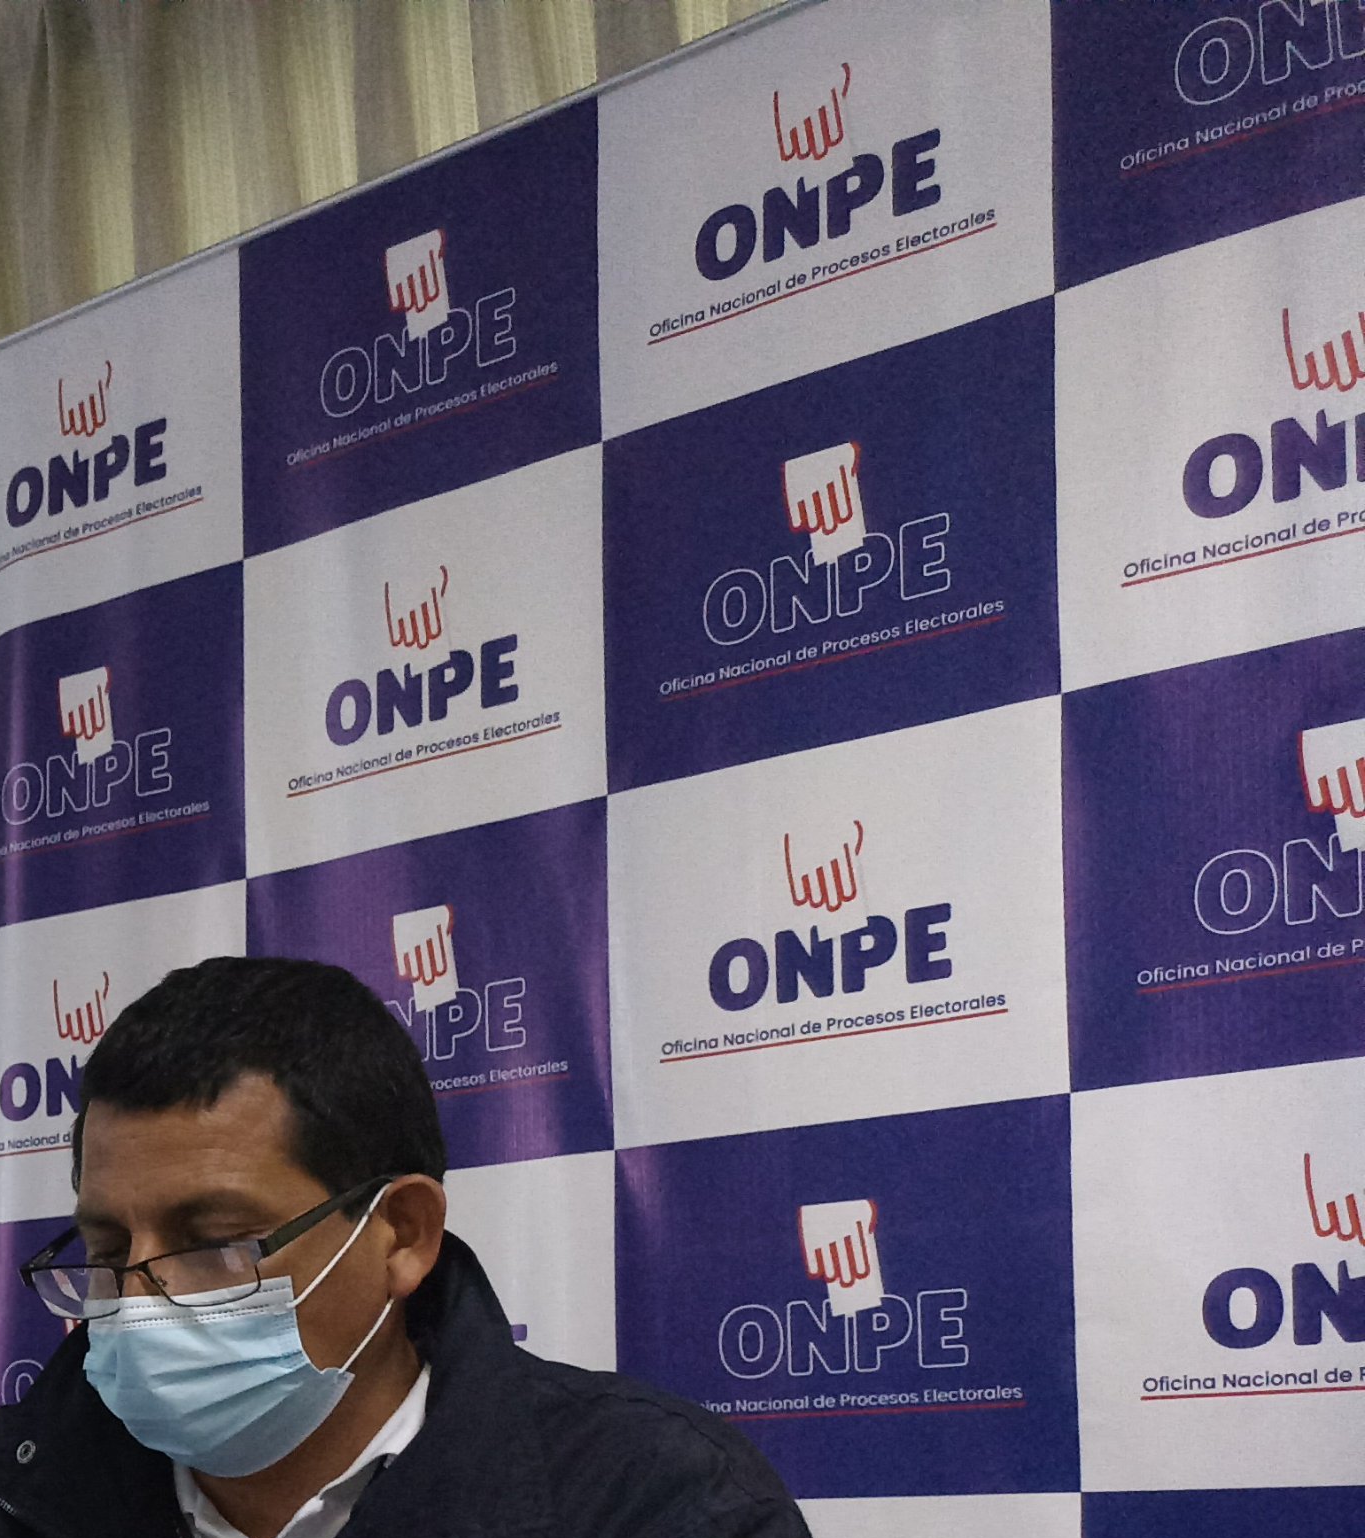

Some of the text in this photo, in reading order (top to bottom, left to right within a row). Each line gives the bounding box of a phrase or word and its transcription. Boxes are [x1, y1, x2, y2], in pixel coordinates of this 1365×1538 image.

[1175, 0, 1365, 106] ON
[1120, 138, 1190, 171] Oficina
[1195, 102, 1287, 145] Nacional
[695, 127, 943, 282] ONPE
[649, 207, 996, 339] Oficina Nacional de Procesos Electorales
[320, 287, 517, 418] ONPE
[332, 416, 391, 450] Nacional
[414, 389, 477, 423] Procesos
[480, 361, 560, 403] Electorales
[5, 417, 167, 528] ONPE
[1182, 408, 1365, 519] ON
[703, 512, 951, 647] ONPE
[1124, 551, 1197, 579] Oficina
[1203, 523, 1297, 561] Nacional
[1303, 518, 1331, 535] de
[325, 633, 520, 747] ONPE
[659, 600, 1005, 697] Oficina Nacional de Procesos Electorales
[1, 727, 173, 827] ONPE
[287, 711, 561, 791] Oficina Nacional de Procesos Electorales
[709, 902, 953, 1012] ONPE
[1137, 962, 1210, 986] Oficina
[1215, 944, 1311, 974] Nacional
[1317, 940, 1346, 960] de
[661, 991, 1006, 1056] Oficina Nacional de Procesos Electorales
[430, 1060, 569, 1092] rocesos Electorales
[718, 1287, 970, 1380] ONPE
[1142, 1375, 1216, 1393] Oficina
[1222, 1369, 1318, 1389] Nacional
[1324, 1367, 1353, 1384] de
[735, 1383, 1023, 1414] Nacional de Procesos Electorales
